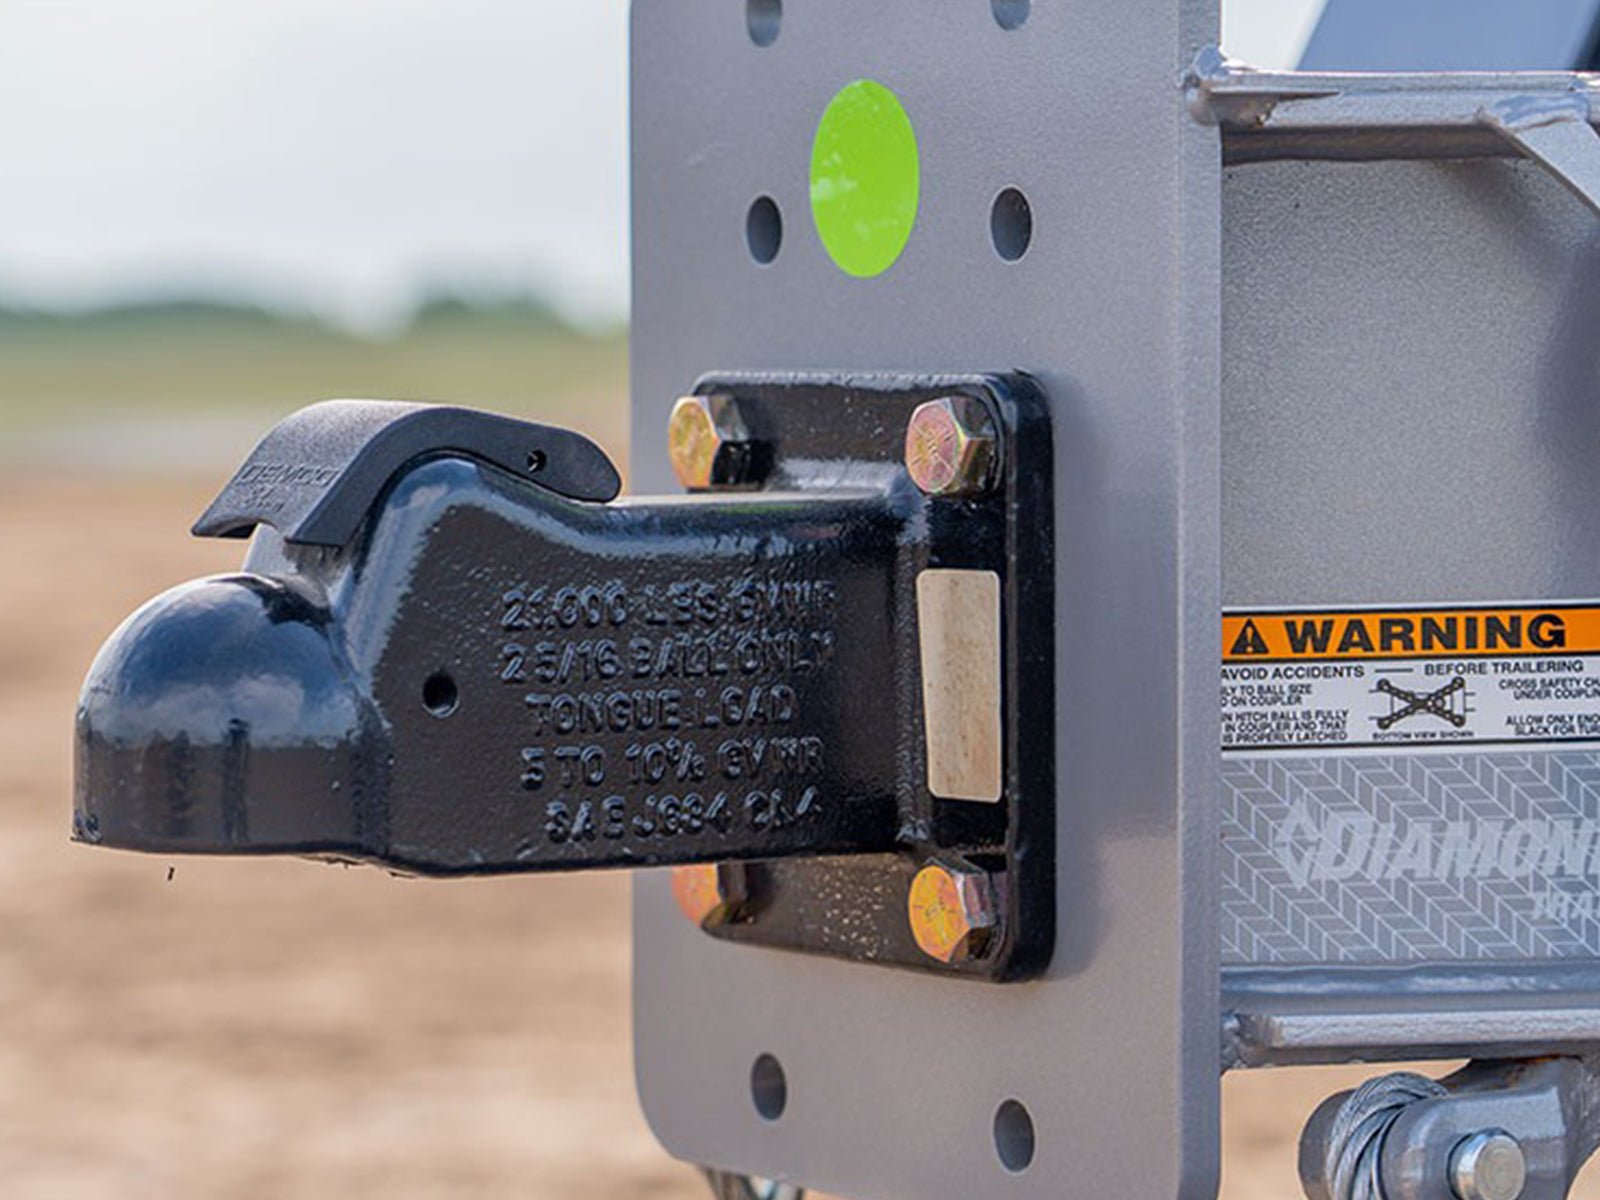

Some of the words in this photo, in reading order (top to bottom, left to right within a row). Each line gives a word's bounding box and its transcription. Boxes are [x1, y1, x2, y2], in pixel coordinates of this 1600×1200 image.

[1283, 614, 1566, 653] WARNING
[1221, 668, 1268, 680] AVOID
[1271, 665, 1365, 679] ACCIDENTS
[1425, 663, 1486, 676] BEFORE
[1492, 660, 1584, 674] TRAILERING
[1240, 685, 1255, 696] TO
[1257, 684, 1285, 695] BALL
[1288, 683, 1313, 695] SIZE
[1499, 679, 1537, 690] CROSS
[1540, 678, 1581, 688] SAFETY
[1230, 696, 1247, 707] ON
[1250, 695, 1302, 706] COUPLER
[1513, 689, 1551, 700] UNDER
[525, 688, 683, 734] TONGUE
[693, 683, 795, 730] LOAD
[1235, 711, 1268, 721] HITCH
[1271, 710, 1299, 721] BALL
[1301, 709, 1312, 720] IS
[1315, 709, 1348, 720] FULLY
[1238, 722, 1291, 733] COUPLER
[1294, 721, 1317, 731] AND
[1319, 720, 1347, 730] THAT
[1505, 715, 1543, 726] ALLOW
[1546, 714, 1574, 724] ONLY
[1236, 732, 1293, 742] PROPERLY
[1296, 731, 1347, 741] LATCHED
[1514, 725, 1550, 736] SLACK
[1553, 724, 1575, 735] FOR
[521, 746, 546, 790] 5
[553, 744, 605, 788] TO
[625, 736, 704, 784] 10%
[545, 794, 627, 843] SAE
[1310, 811, 1600, 880] DIAMON
